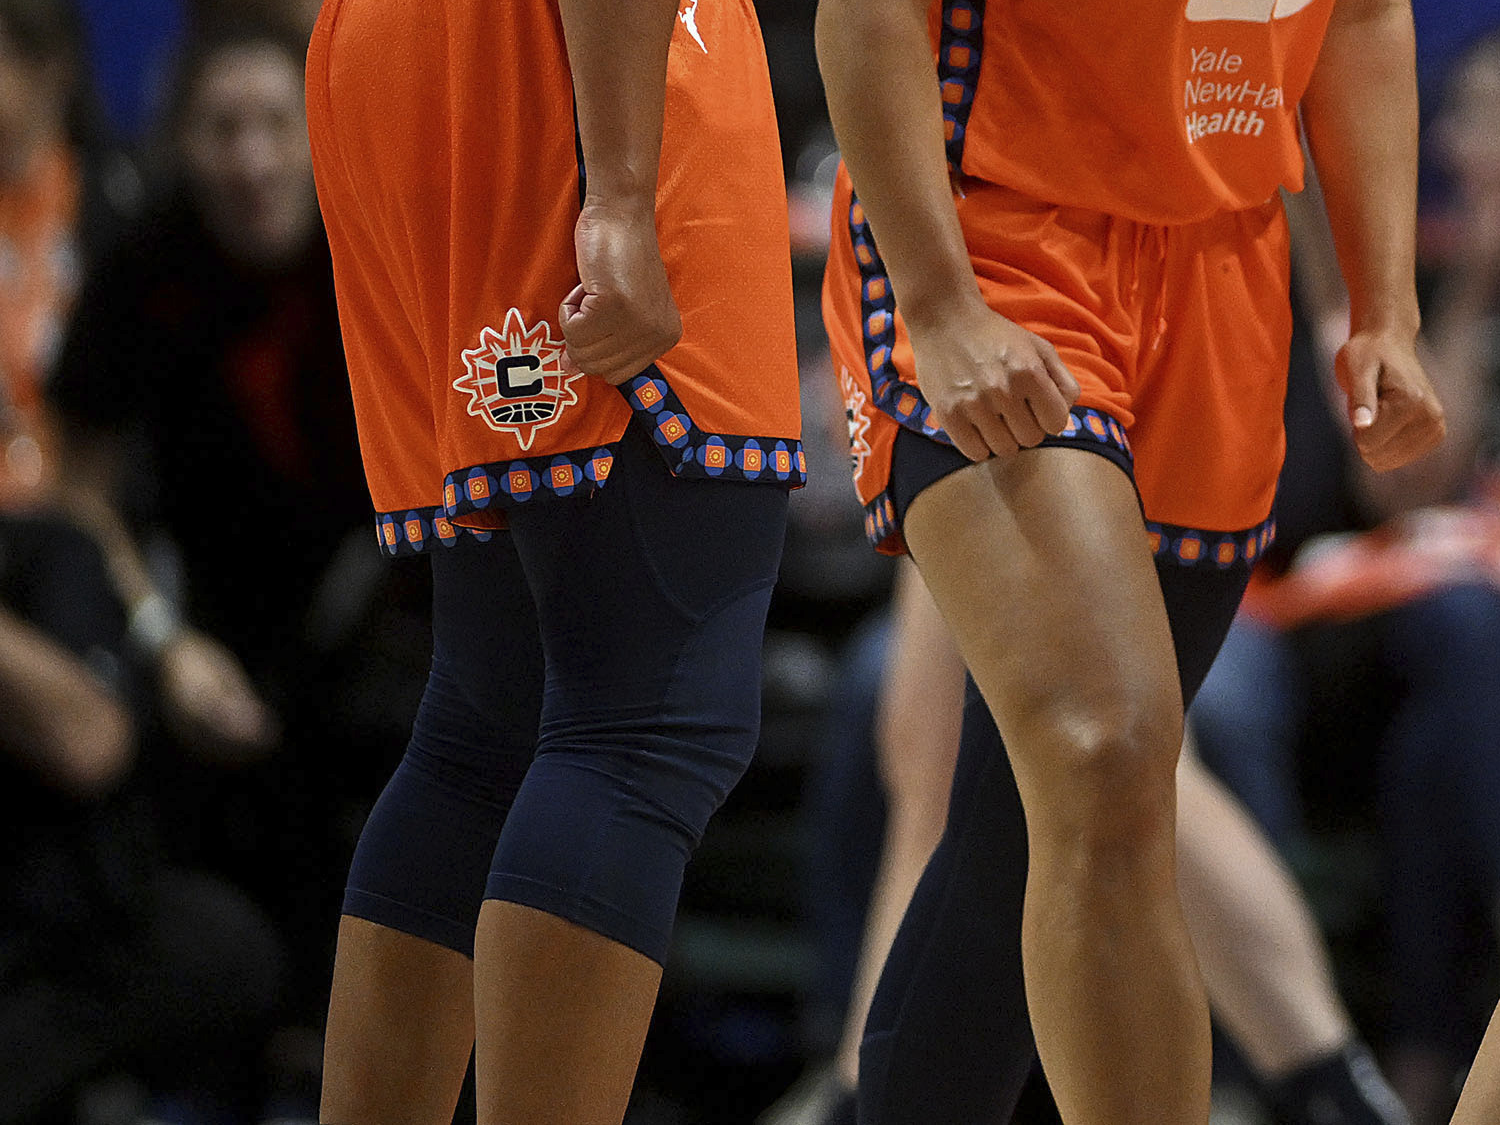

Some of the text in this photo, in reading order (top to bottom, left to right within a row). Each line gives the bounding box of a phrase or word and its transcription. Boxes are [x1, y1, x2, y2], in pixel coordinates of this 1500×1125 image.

[1191, 46, 1243, 74] Yale
[1185, 108, 1265, 144] Health
[496, 354, 544, 399] C
